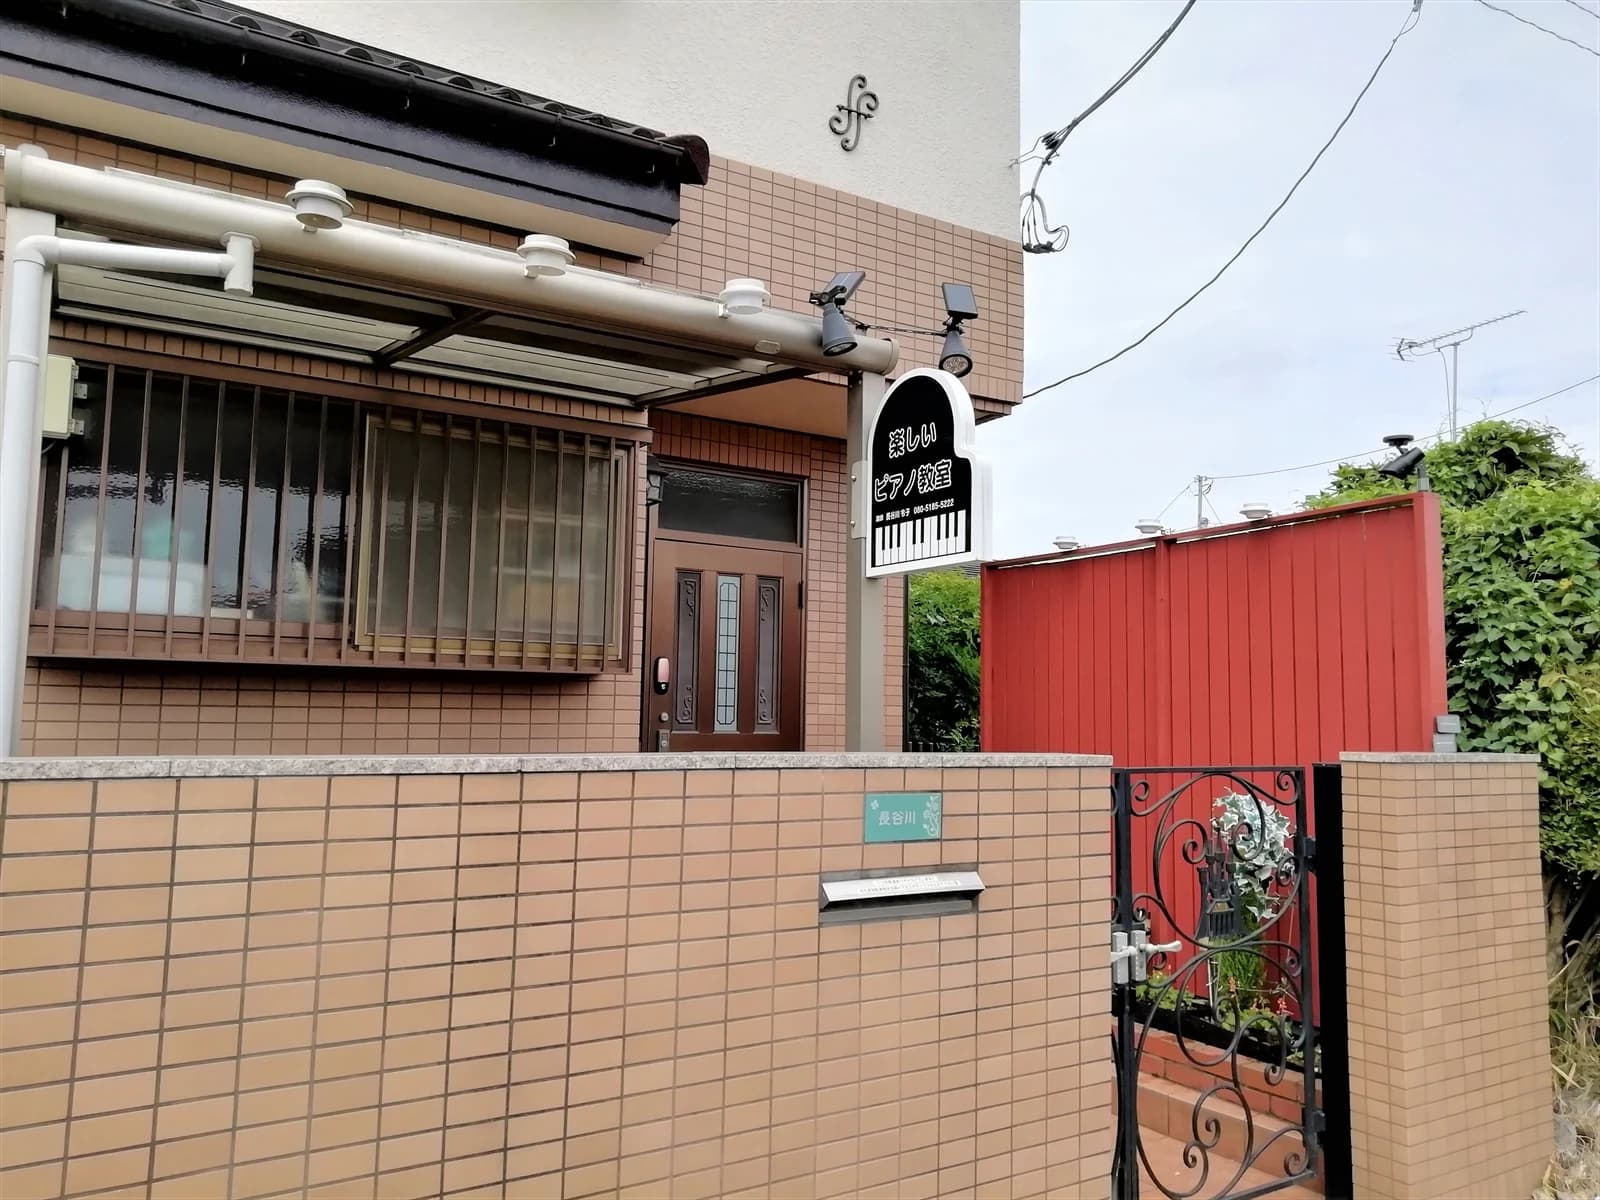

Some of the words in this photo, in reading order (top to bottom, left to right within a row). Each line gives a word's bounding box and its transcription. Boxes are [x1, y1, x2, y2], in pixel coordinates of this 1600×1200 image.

[889, 422, 937, 458] 楽しい
[874, 458, 952, 502] ピアノ教室
[879, 811, 916, 826] 長谷川
